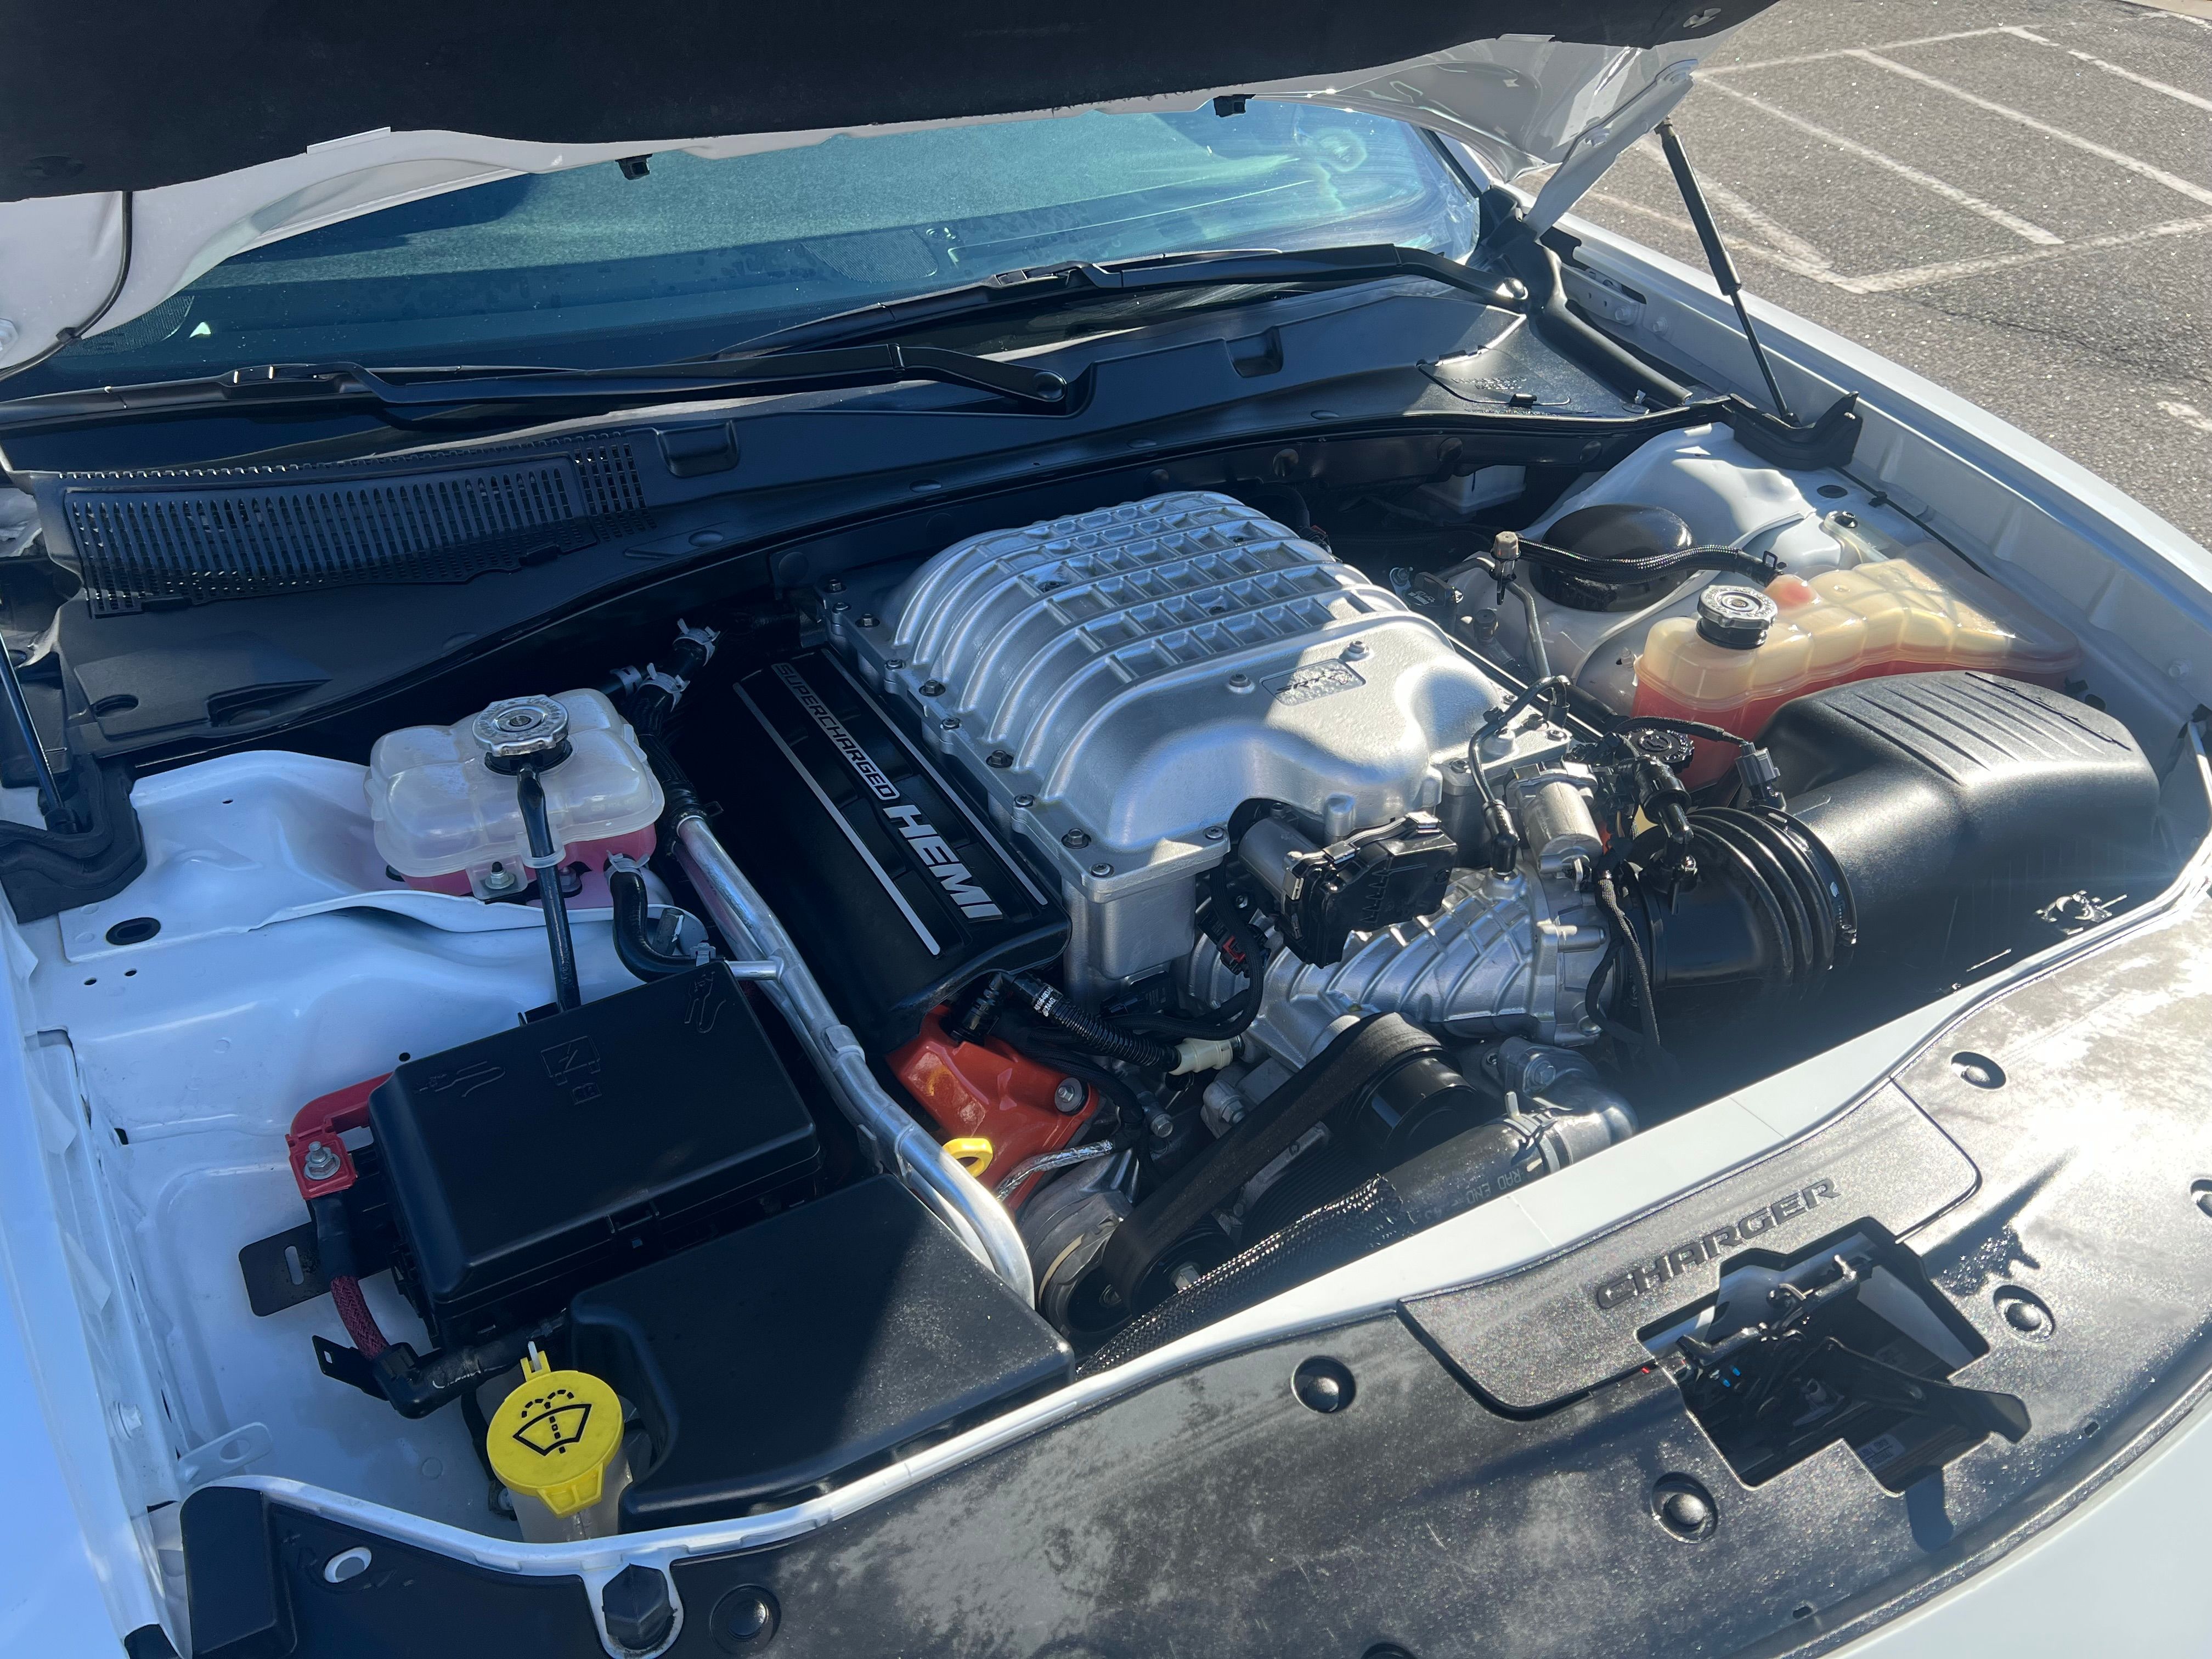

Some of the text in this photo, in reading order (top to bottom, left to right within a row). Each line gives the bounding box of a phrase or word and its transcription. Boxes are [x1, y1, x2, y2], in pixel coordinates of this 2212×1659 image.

[775, 664, 896, 798] SUPERCHARGED
[883, 805, 1003, 920] HEMI
[1465, 1169, 1522, 1204] RAD END
[1596, 1178, 1842, 1309] CHARGER
